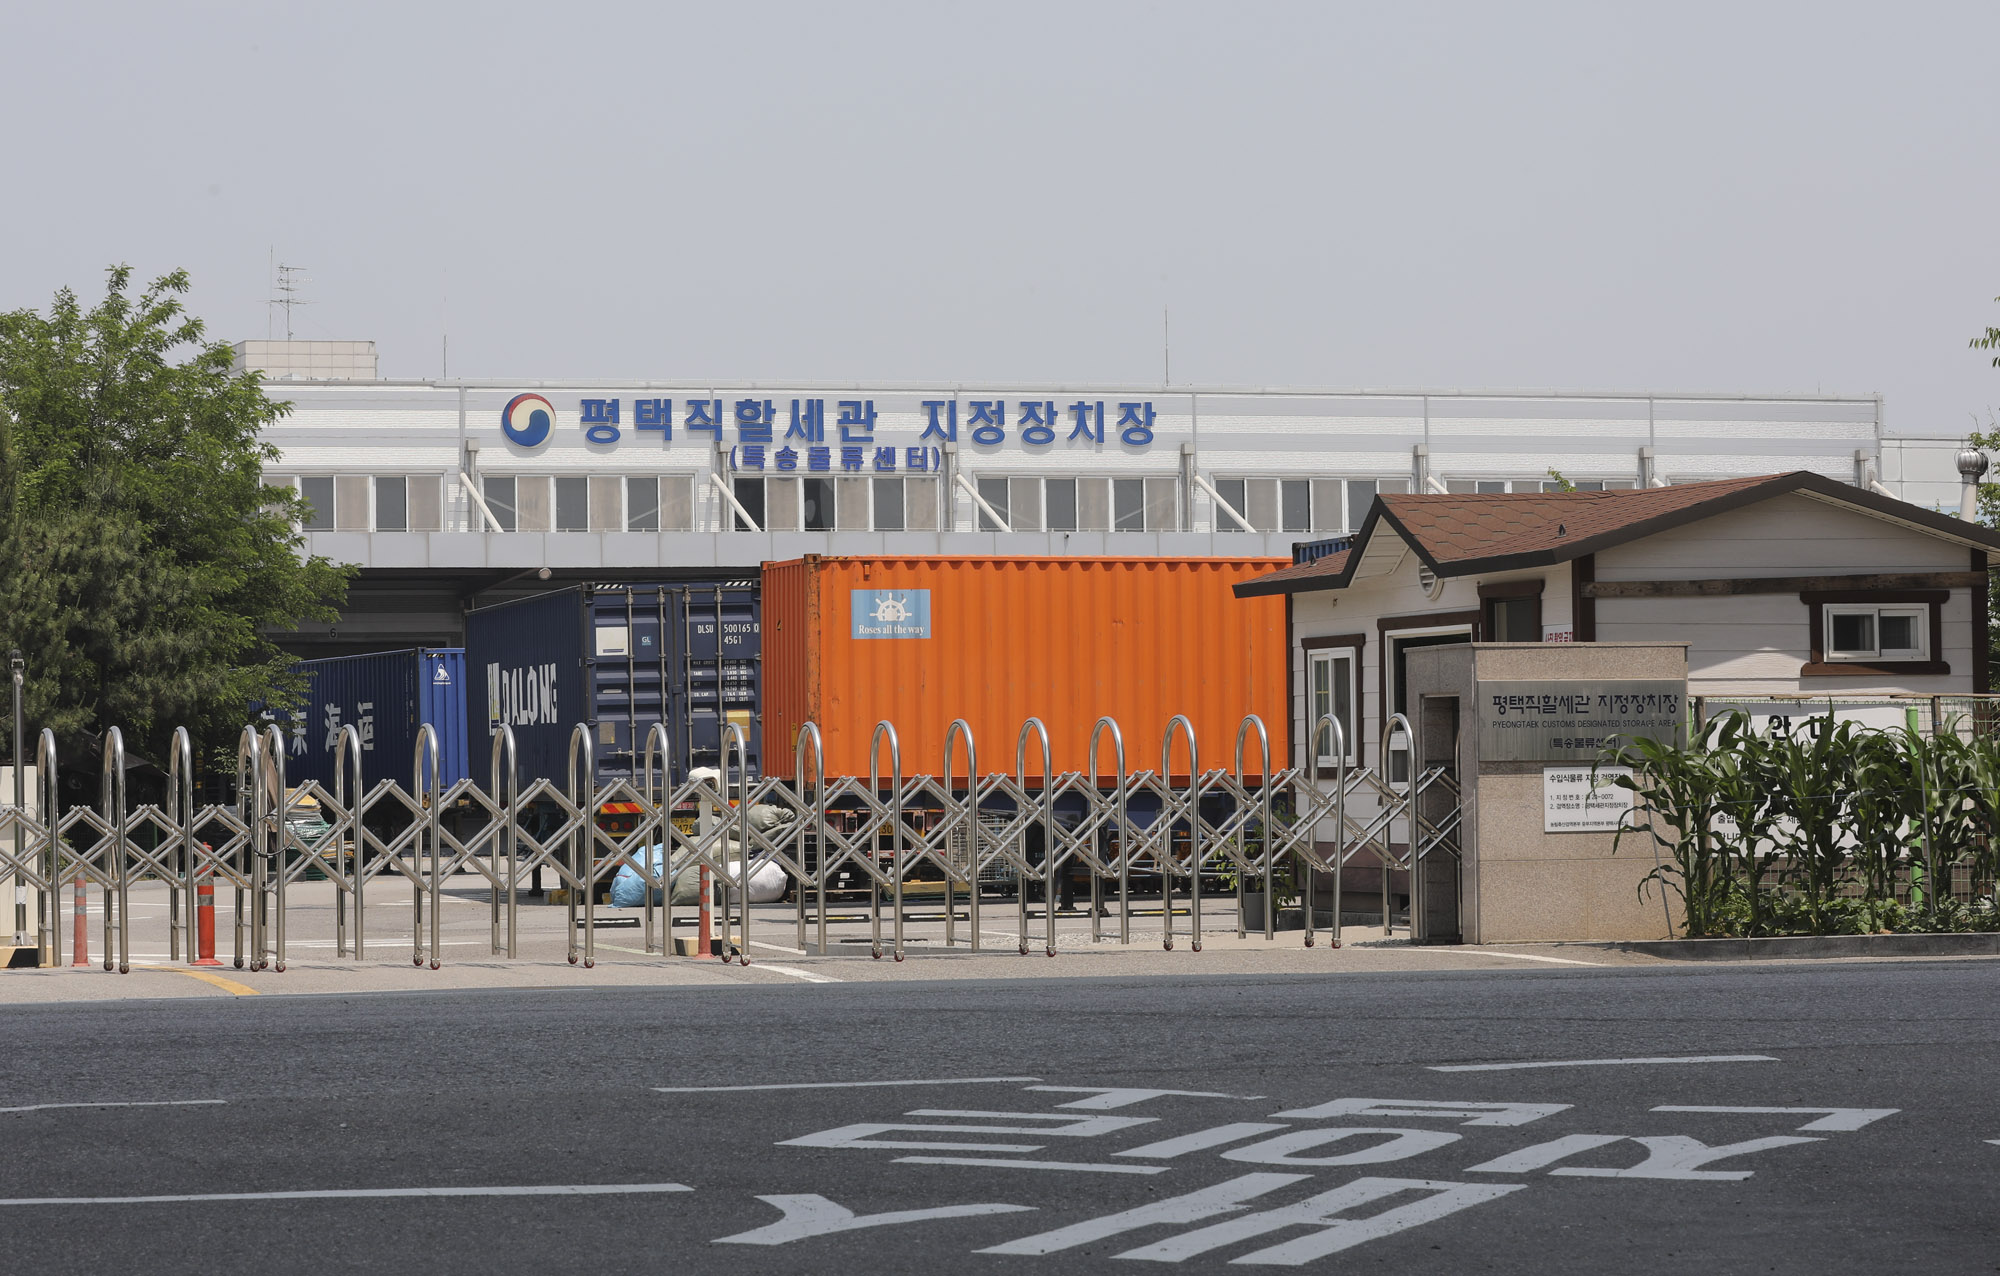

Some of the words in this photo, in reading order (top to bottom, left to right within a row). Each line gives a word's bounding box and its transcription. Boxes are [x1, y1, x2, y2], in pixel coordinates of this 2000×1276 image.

[580, 398, 878, 444] 평택직할세관
[920, 400, 1157, 446] 지정장치장
[730, 445, 940, 472] (특송물류센터)
[697, 624, 714, 634] DLSU
[723, 623, 751, 633] 500165
[858, 624, 881, 634] Roses
[882, 624, 892, 634] all
[894, 624, 908, 634] the
[908, 626, 925, 636] way
[723, 635, 742, 645] 45G1
[1493, 694, 1590, 715] 평택직할세관
[1598, 694, 1678, 715] 지정장치장
[1493, 720, 1540, 729] PYEONGTAEK
[1542, 720, 1576, 728] CUSTOMS
[1577, 719, 1621, 728] DESIGNATED
[1622, 719, 1656, 728] STORAGE
[1658, 719, 1677, 728] AREA
[1549, 773, 1583, 783] 수입식물류
